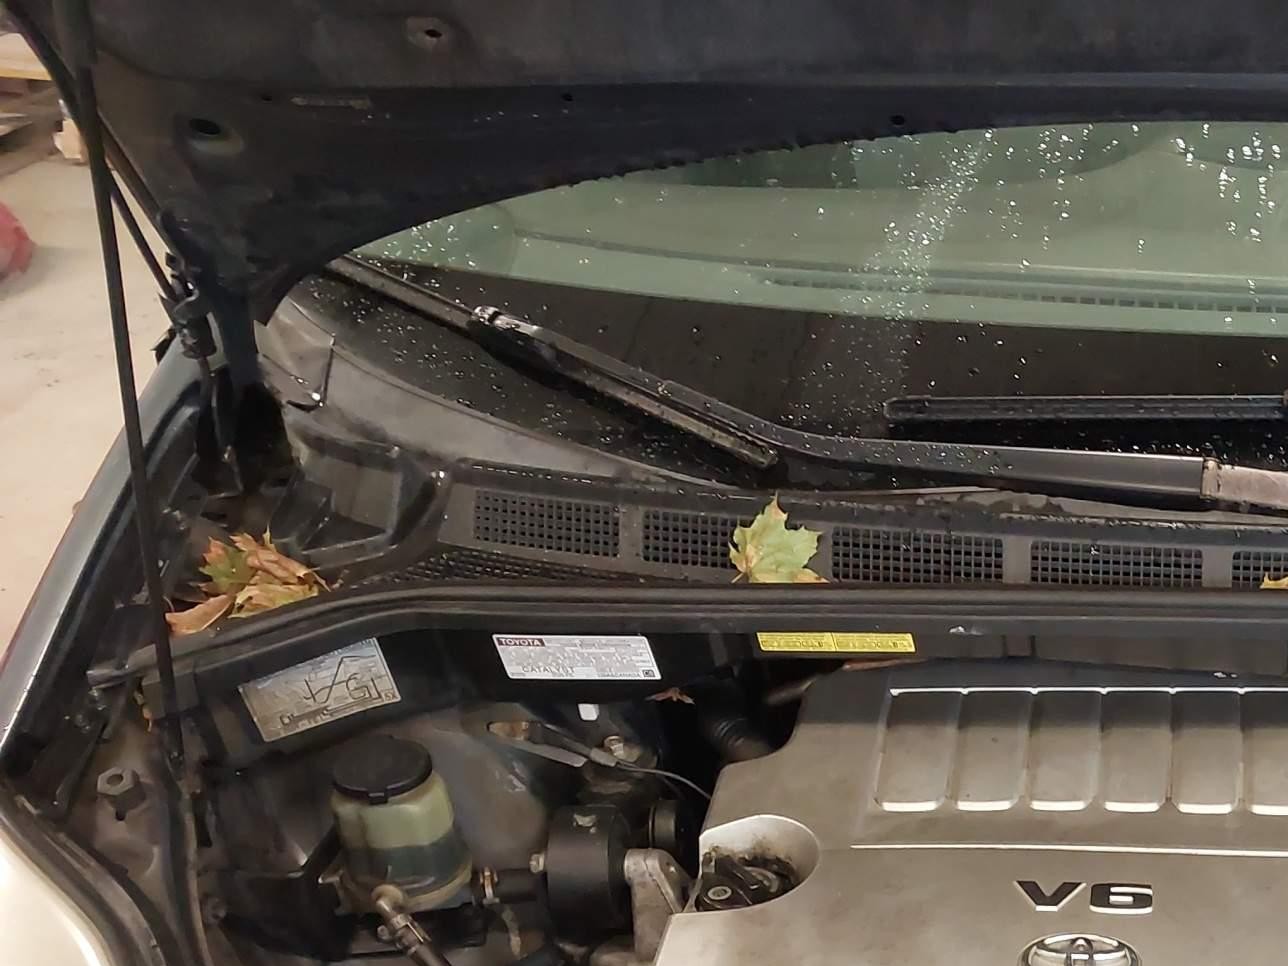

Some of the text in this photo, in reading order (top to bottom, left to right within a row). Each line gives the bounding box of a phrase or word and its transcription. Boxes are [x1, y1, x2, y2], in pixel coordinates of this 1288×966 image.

[500, 638, 541, 646] TOYOTA
[522, 665, 575, 673] CATALYST
[1013, 880, 1153, 915] V6
